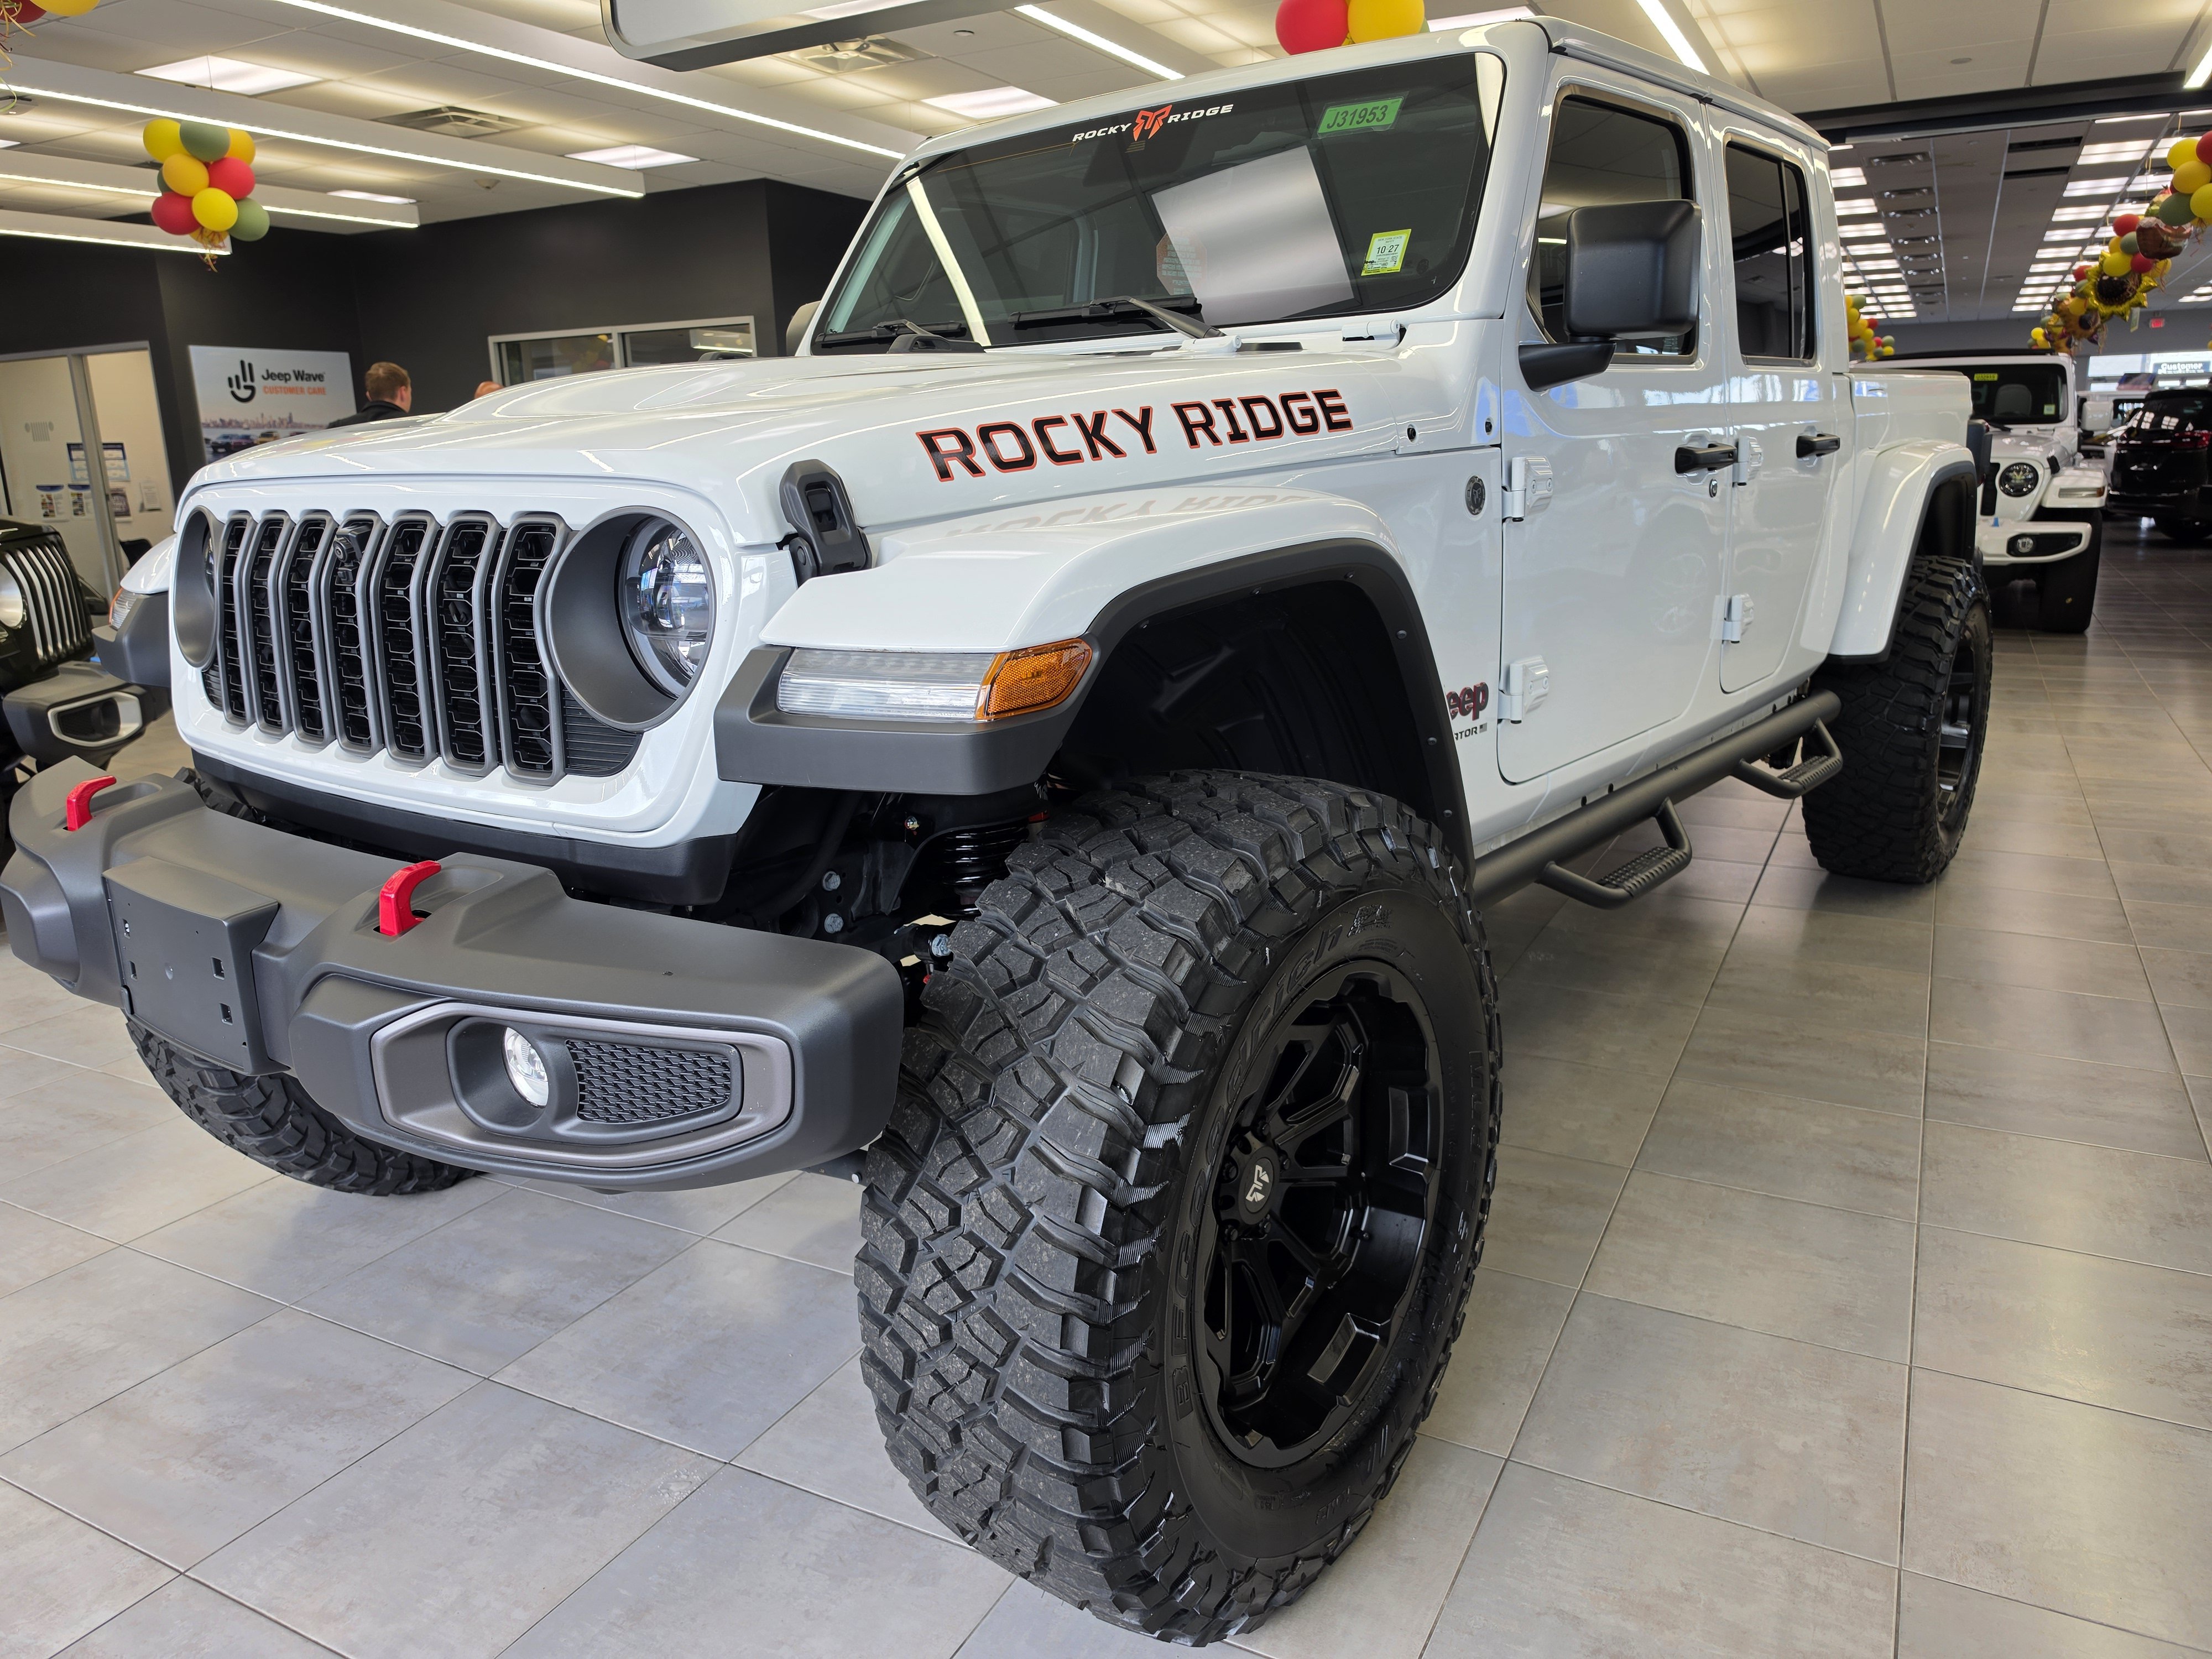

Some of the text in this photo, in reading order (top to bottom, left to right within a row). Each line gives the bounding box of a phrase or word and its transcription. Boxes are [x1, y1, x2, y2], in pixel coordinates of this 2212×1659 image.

[1072, 104, 1233, 142] ROCKY RIDGE
[1326, 105, 1389, 129] J31953
[1377, 244, 1400, 254] 10-27
[262, 369, 325, 383] Jeep Wave
[263, 386, 327, 395] CUSTOMER CARE
[916, 389, 1353, 482] ROCKY RIDGE
[1447, 682, 1489, 721] eep
